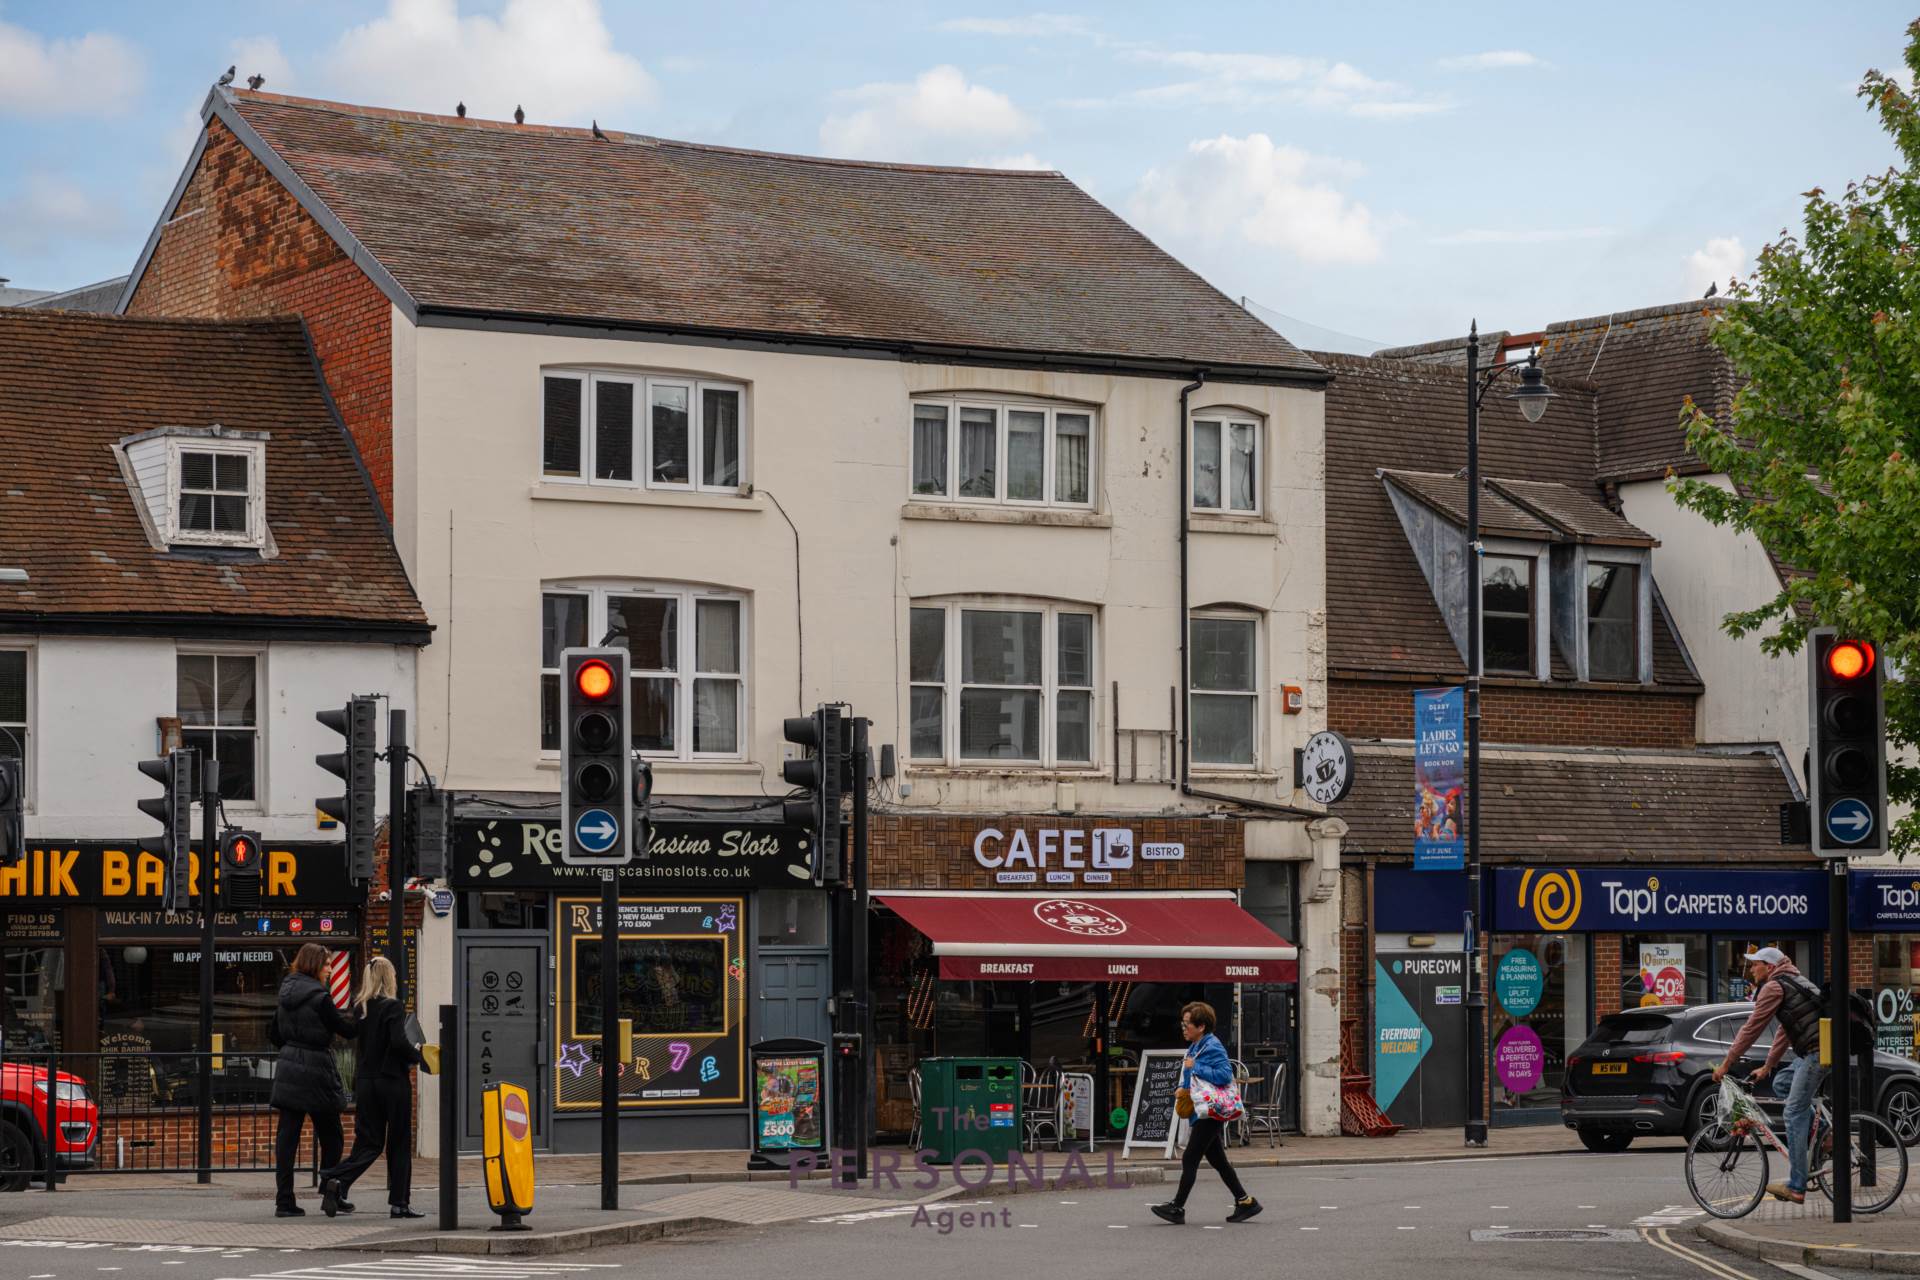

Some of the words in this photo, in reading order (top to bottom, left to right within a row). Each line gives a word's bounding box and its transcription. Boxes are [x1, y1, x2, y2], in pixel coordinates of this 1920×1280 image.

[1422, 729, 1457, 742] LADIES
[1420, 743, 1444, 754] LET'S
[1445, 741, 1460, 753] GO
[1316, 775, 1344, 801] CAFE
[717, 830, 780, 857] Slots
[974, 828, 1085, 868] CAFE
[1094, 831, 1110, 867] 1
[1146, 846, 1180, 857] BISTRO
[1836, 863, 1846, 874] 17
[603, 870, 613, 881] 15
[1601, 877, 1660, 922] Tapi
[1664, 894, 1733, 915] CARPETS
[1735, 895, 1748, 915] &
[1750, 895, 1808, 915] FLOORS
[1877, 881, 1920, 911] Tapi
[7, 914, 35, 924] FIND
[39, 914, 56, 924] US
[105, 912, 151, 925] WALK-IN
[155, 912, 162, 924] 7
[165, 912, 193, 924] DAYS
[214, 912, 238, 924] EEK
[1070, 924, 1120, 935] CAFE
[173, 952, 184, 963] NO
[185, 952, 241, 963] APPTMENT
[242, 952, 273, 962] NEEDED
[1655, 946, 1669, 958] Tapi
[980, 963, 1034, 974] BREAKFAST
[1404, 960, 1461, 975] PUREGYM
[1652, 958, 1683, 967] BIRTHDAY
[1107, 964, 1139, 975] LUNCH
[1225, 966, 1259, 976] DINNER
[1656, 977, 1685, 997] 50%
[1509, 997, 1535, 1005] REMOVE
[1877, 988, 1914, 1024] 0%
[1899, 1014, 1913, 1022] APR
[100, 1033, 152, 1046] Welcome
[1380, 1027, 1423, 1041] EVERYBODY
[1381, 1040, 1418, 1054] WELCOME
[1877, 1037, 1913, 1046] INTEREST
[668, 1042, 691, 1072] 7
[763, 1125, 795, 1136] £500
